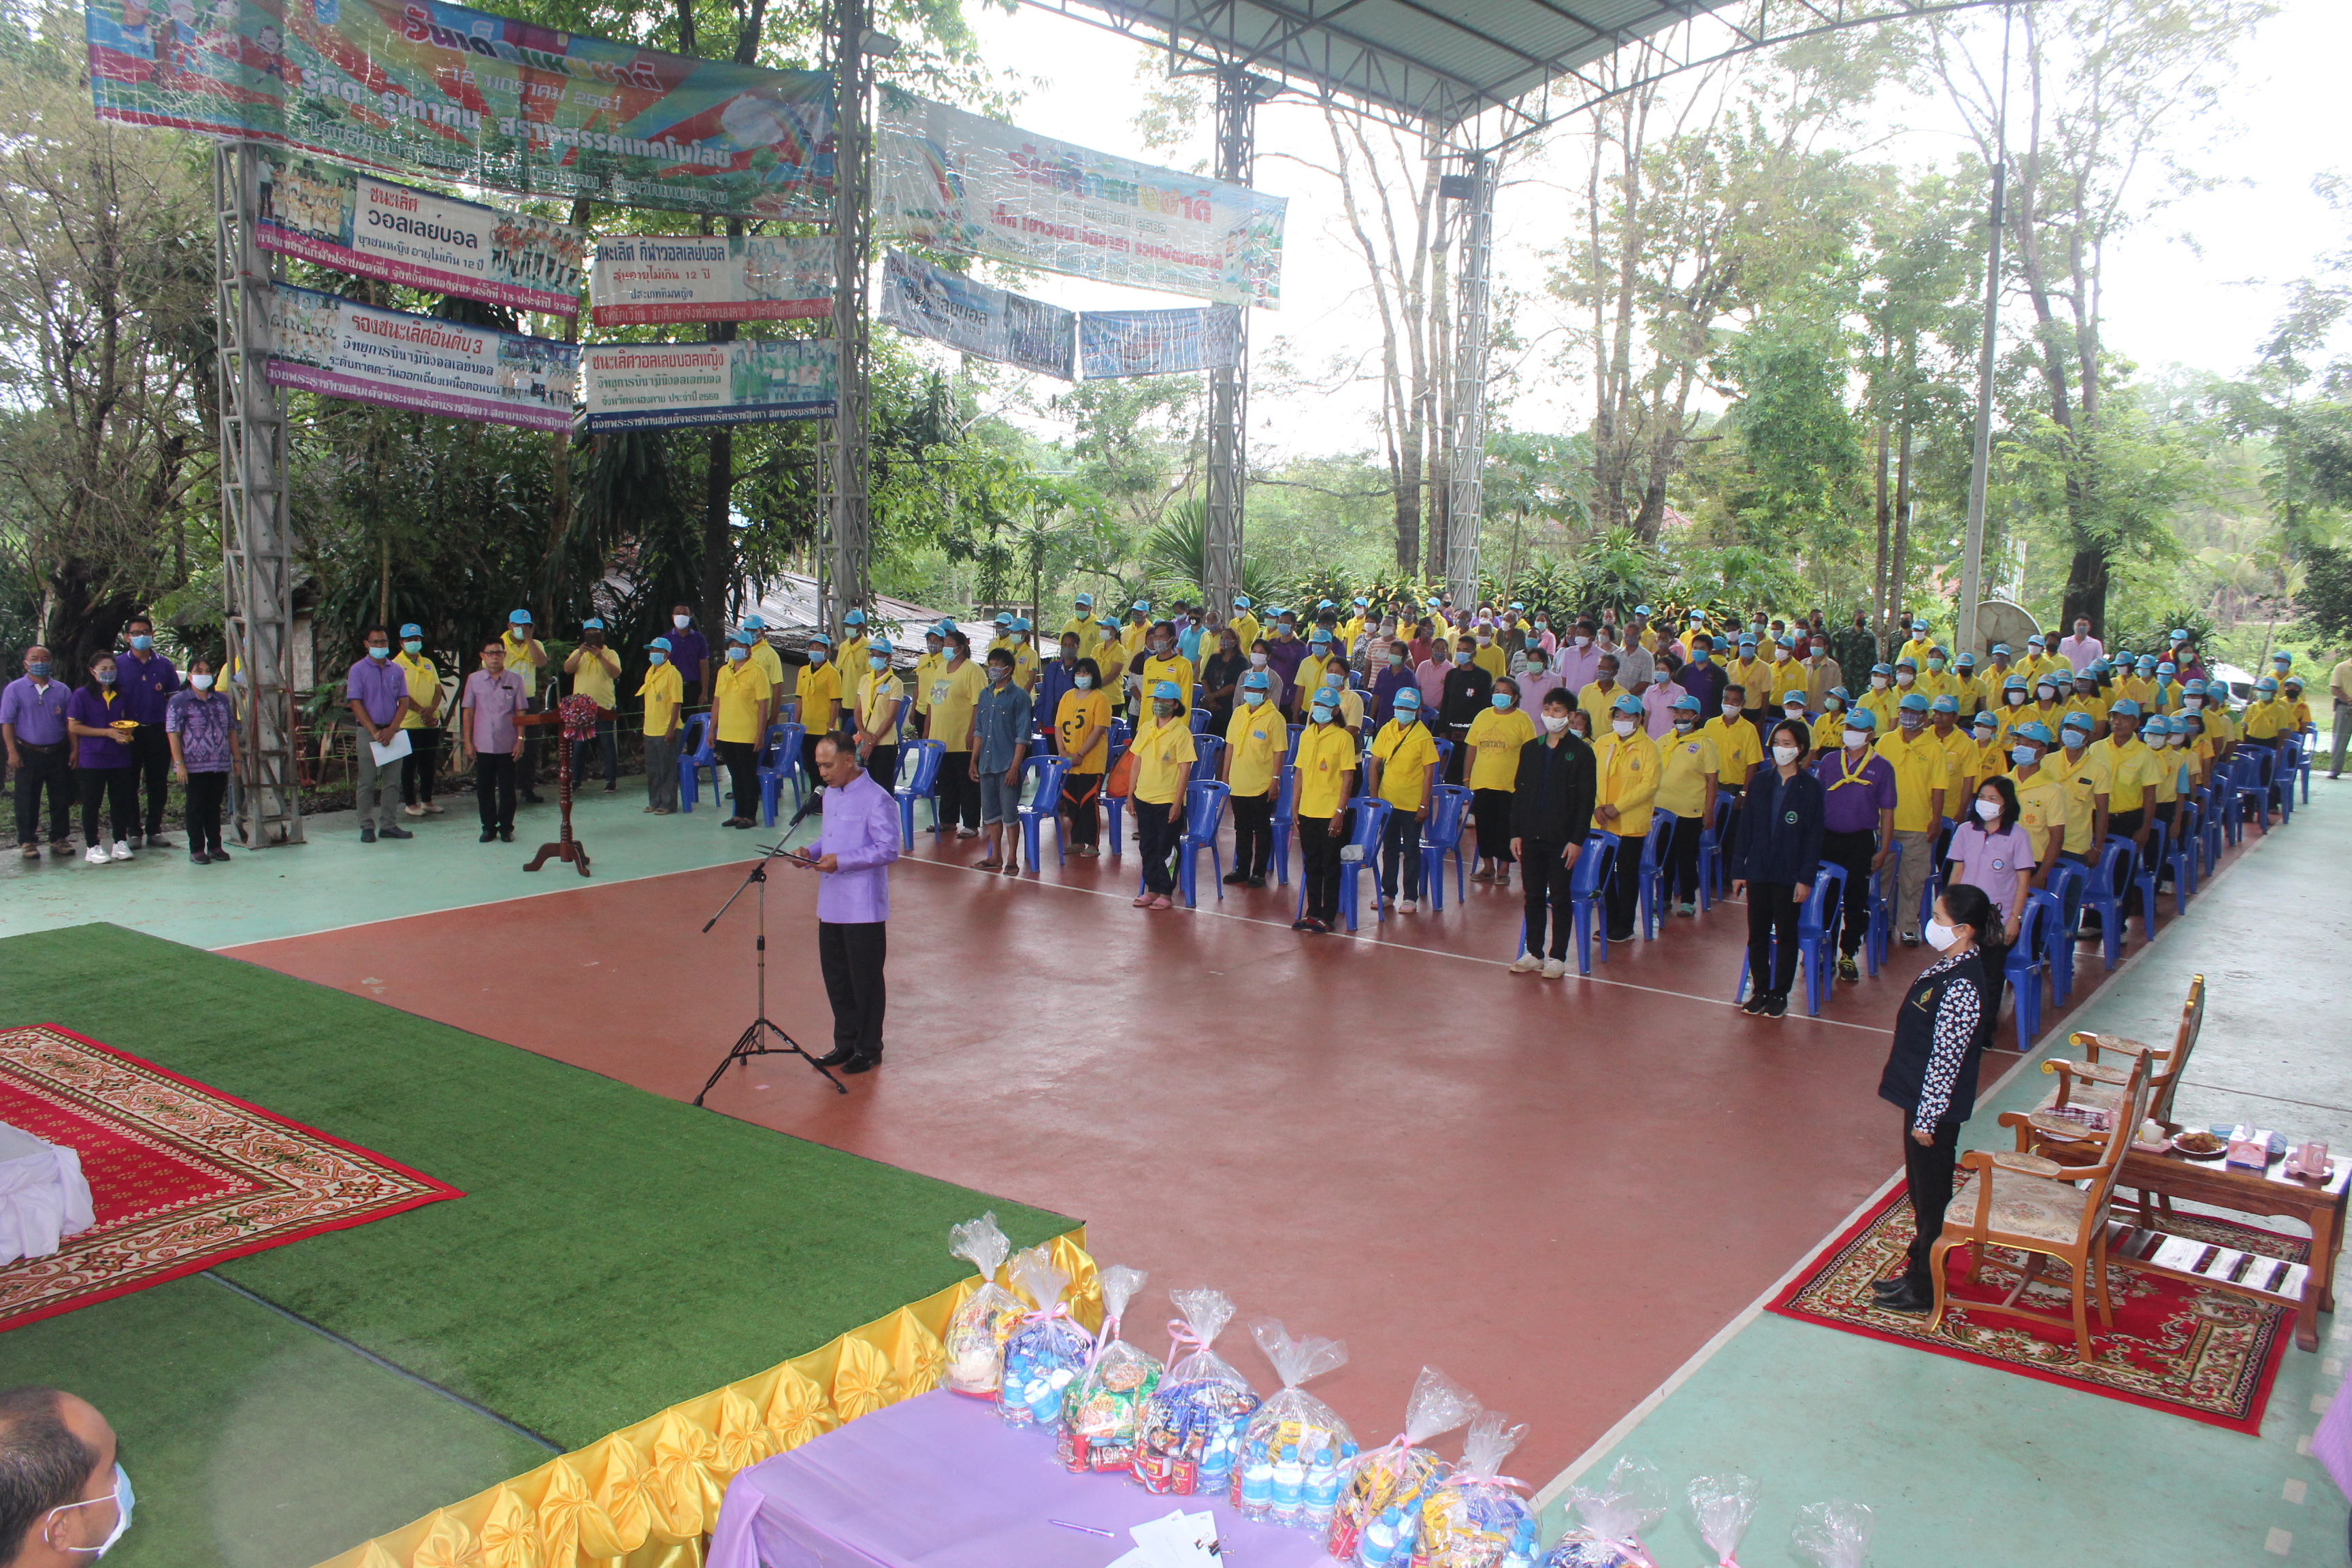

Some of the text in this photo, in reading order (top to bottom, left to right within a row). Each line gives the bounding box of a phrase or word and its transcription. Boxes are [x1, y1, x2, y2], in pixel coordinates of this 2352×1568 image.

[404, 2, 664, 93] วันเด็กแห่งชาติ
[450, 67, 622, 112] 12 มกราคม 2561
[370, 186, 419, 213] ชนะเลิศ
[368, 210, 478, 249] วอลเลย์บอล
[1022, 216, 1075, 242] เยาวชน
[1136, 217, 1167, 235] 2562
[357, 235, 484, 271] ยุวชนหญิง อายุไม่เกิน 12 ปี
[640, 240, 725, 261] กีฬาวอลเลย์บอล
[392, 265, 470, 294] จังหวัดหนองคาย
[518, 293, 551, 309] ประจำปี
[613, 265, 711, 283] รุ่นอายุไม่เกิน 12 ปี
[630, 287, 693, 300] ประเภททีมหญิง
[352, 314, 472, 354] รองชนะเลิศอันดับ
[329, 355, 500, 395] ระดับภาคตะวันออกเฉียงเหนือตอนบน
[602, 390, 719, 406] จังหวัดหนองคาย ประจำปี 2559
